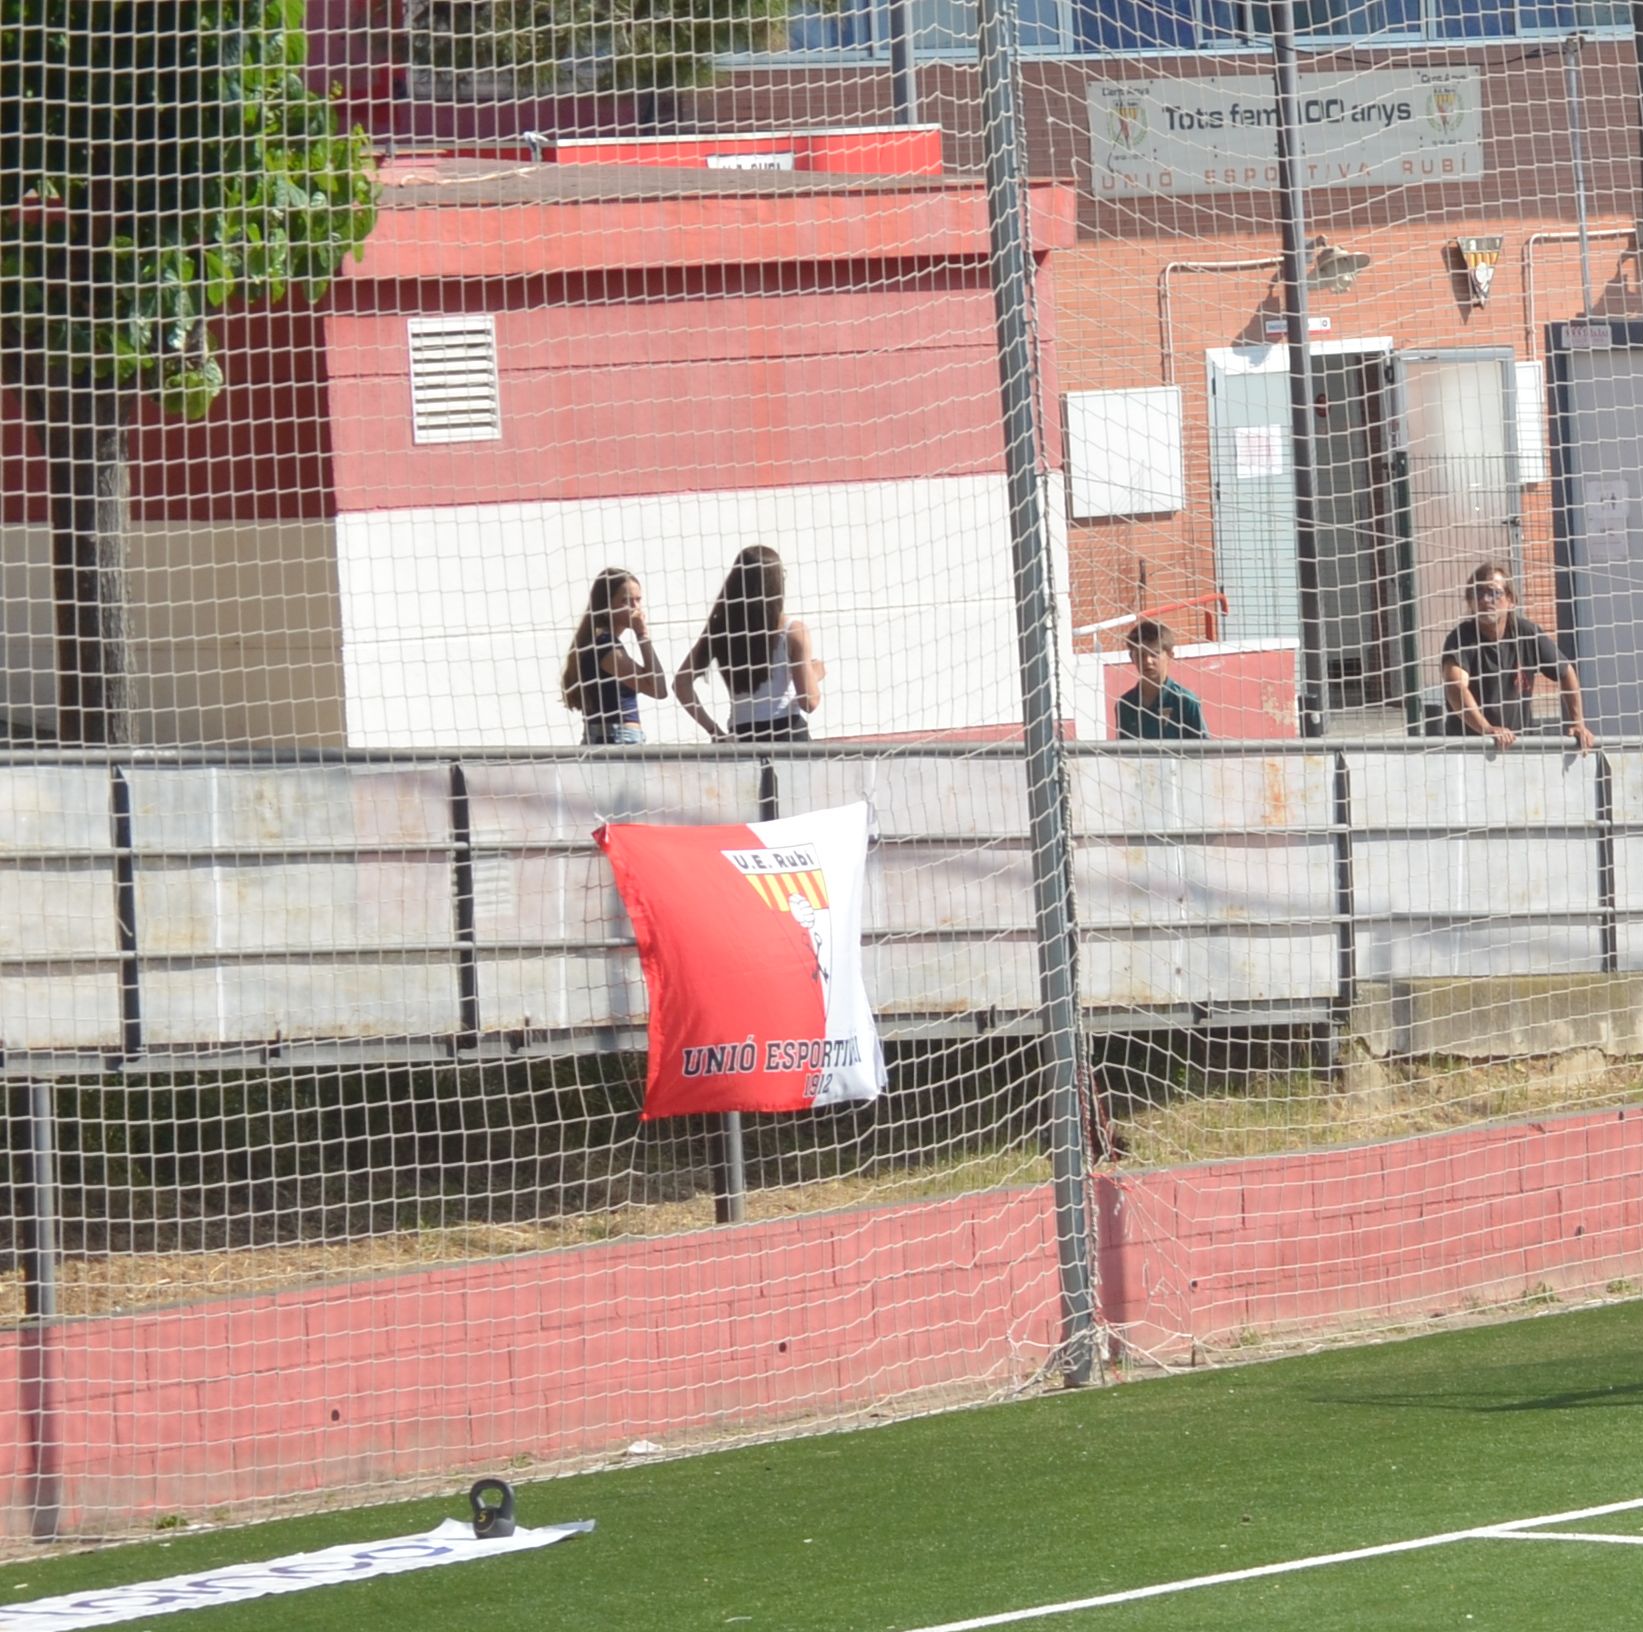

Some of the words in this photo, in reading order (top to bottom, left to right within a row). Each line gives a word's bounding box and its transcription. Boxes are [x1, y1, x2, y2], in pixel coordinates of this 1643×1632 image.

[1162, 104, 1224, 130] Tots
[1229, 102, 1278, 127] fem
[1351, 102, 1412, 127] anys
[1204, 161, 1371, 185] ESPOTIVA
[733, 855, 773, 870] U.E.
[683, 1034, 756, 1075] UNIÓ
[804, 1074, 833, 1097] 1912
[477, 1510, 487, 1523] 5
